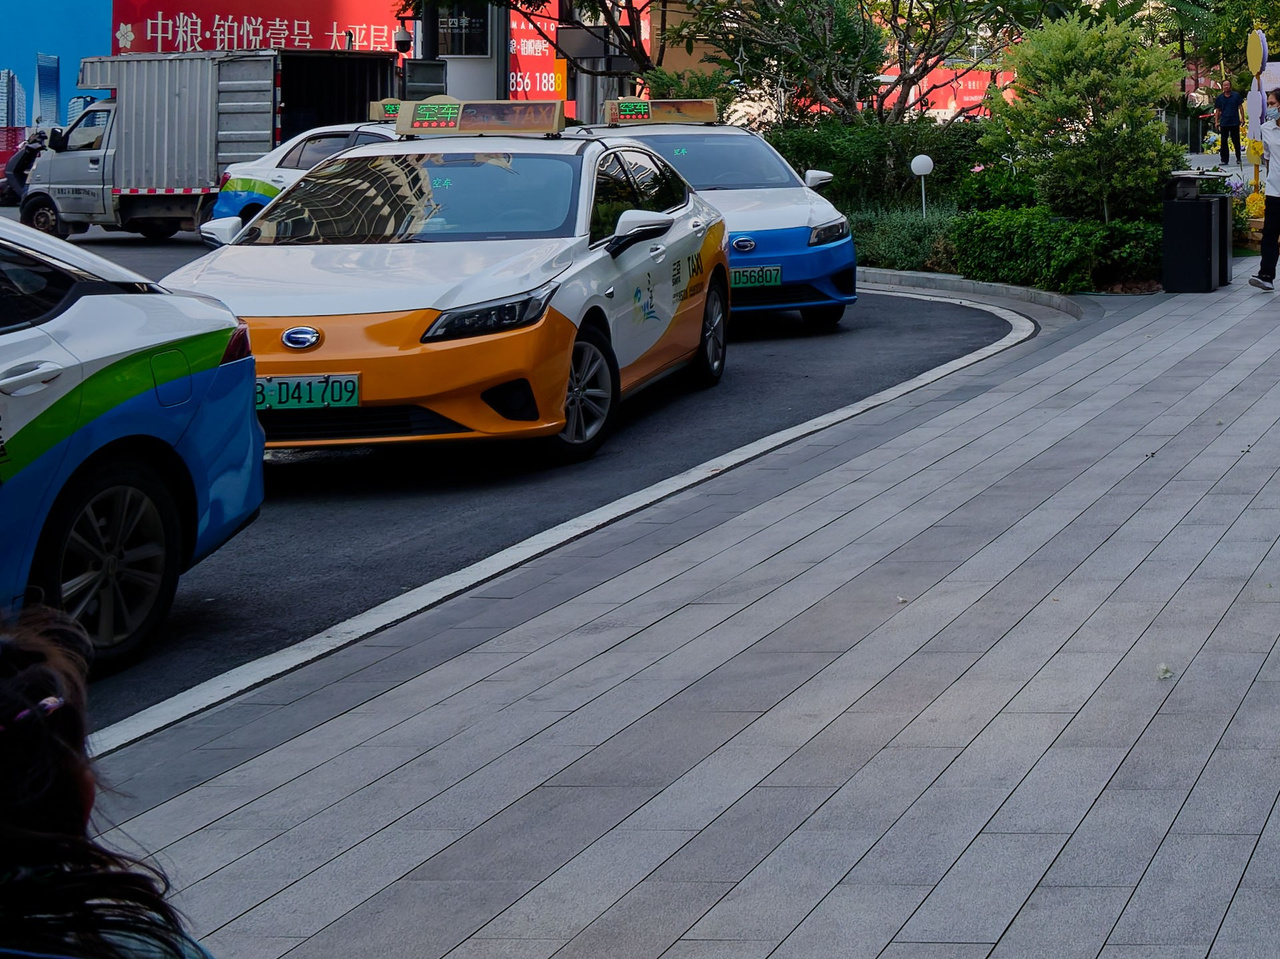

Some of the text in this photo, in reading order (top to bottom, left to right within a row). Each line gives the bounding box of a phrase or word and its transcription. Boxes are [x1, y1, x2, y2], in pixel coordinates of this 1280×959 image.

[509, 71, 563, 93] 856 1888
[416, 104, 460, 121] 空车
[620, 102, 648, 115] 空车
[687, 252, 704, 279] TAXI
[733, 267, 781, 285] D56807
